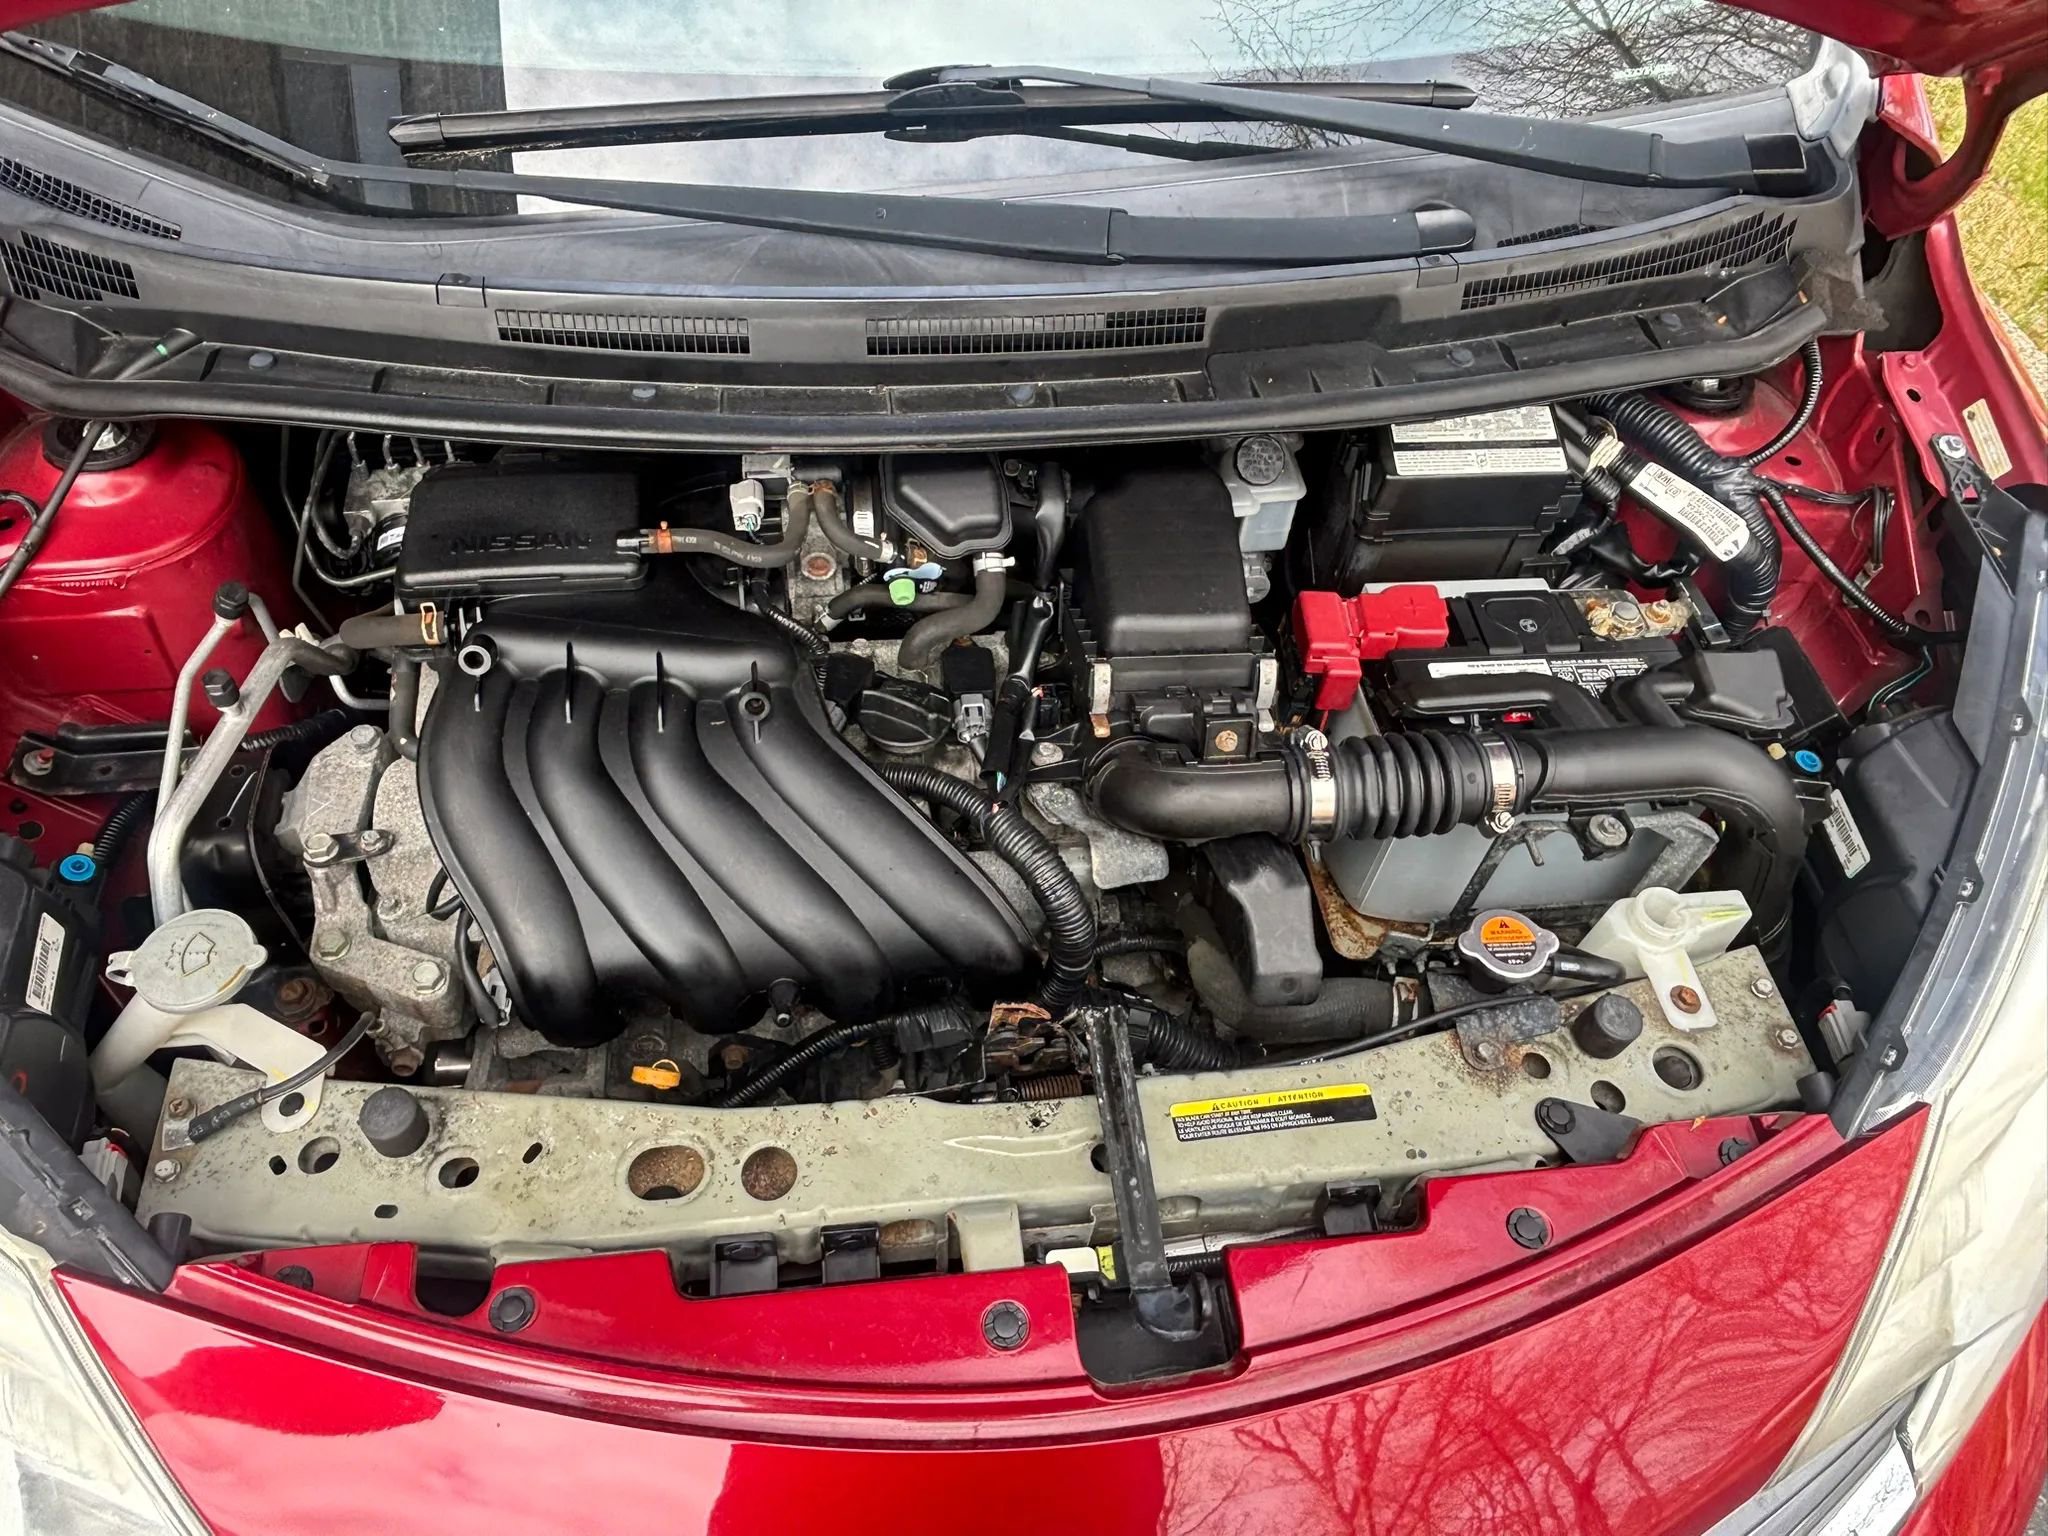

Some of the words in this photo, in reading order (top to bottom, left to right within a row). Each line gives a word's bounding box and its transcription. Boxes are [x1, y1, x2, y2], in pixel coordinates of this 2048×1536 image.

[449, 532, 593, 555] NISSAN
[1220, 1098, 1259, 1109] CAUTION
[1278, 1091, 1324, 1102] ATTENTION
